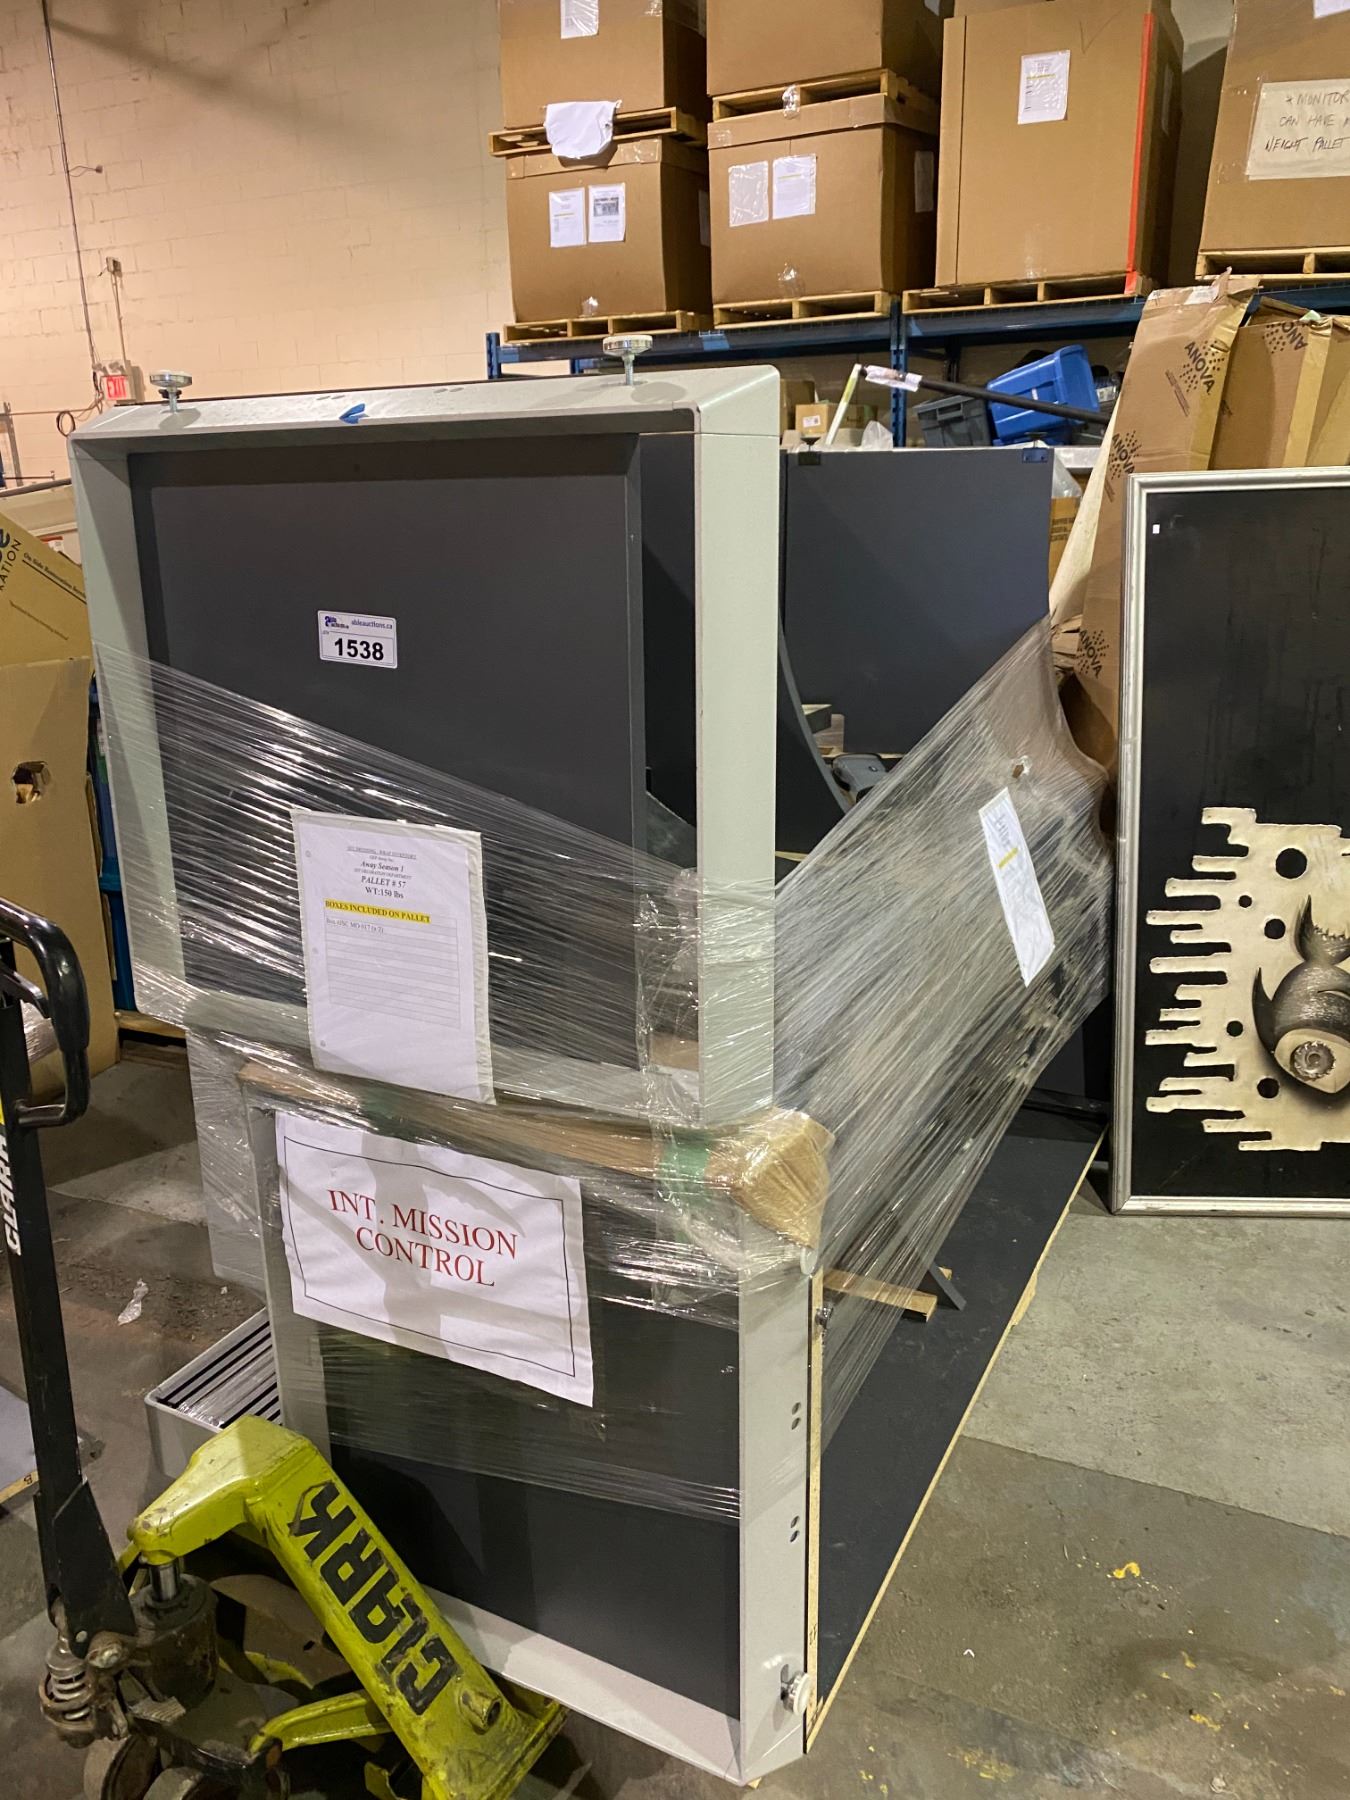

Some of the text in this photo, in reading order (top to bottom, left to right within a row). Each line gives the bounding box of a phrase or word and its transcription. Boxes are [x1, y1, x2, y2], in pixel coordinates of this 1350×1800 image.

[1280, 115, 1298, 128] CAN
[1313, 136, 1350, 153] PALLET
[1184, 341, 1216, 394] ANOVA
[106, 376, 127, 399] EXIT
[1112, 433, 1135, 475] ANOVA
[334, 637, 384, 661] 1538
[1080, 630, 1102, 679] ANOVA
[361, 861, 377, 870] Away
[378, 863, 399, 872] Season
[361, 875, 390, 886] PALLET
[398, 880, 407, 888] 57
[365, 887, 404, 899] WT:150 lbs
[325, 900, 430, 923] BOXES INCLUDED ON PALLET
[327, 1189, 518, 1260] INT. MISSION
[356, 1227, 495, 1287] CONTROL
[290, 1483, 457, 1716] CLARK
